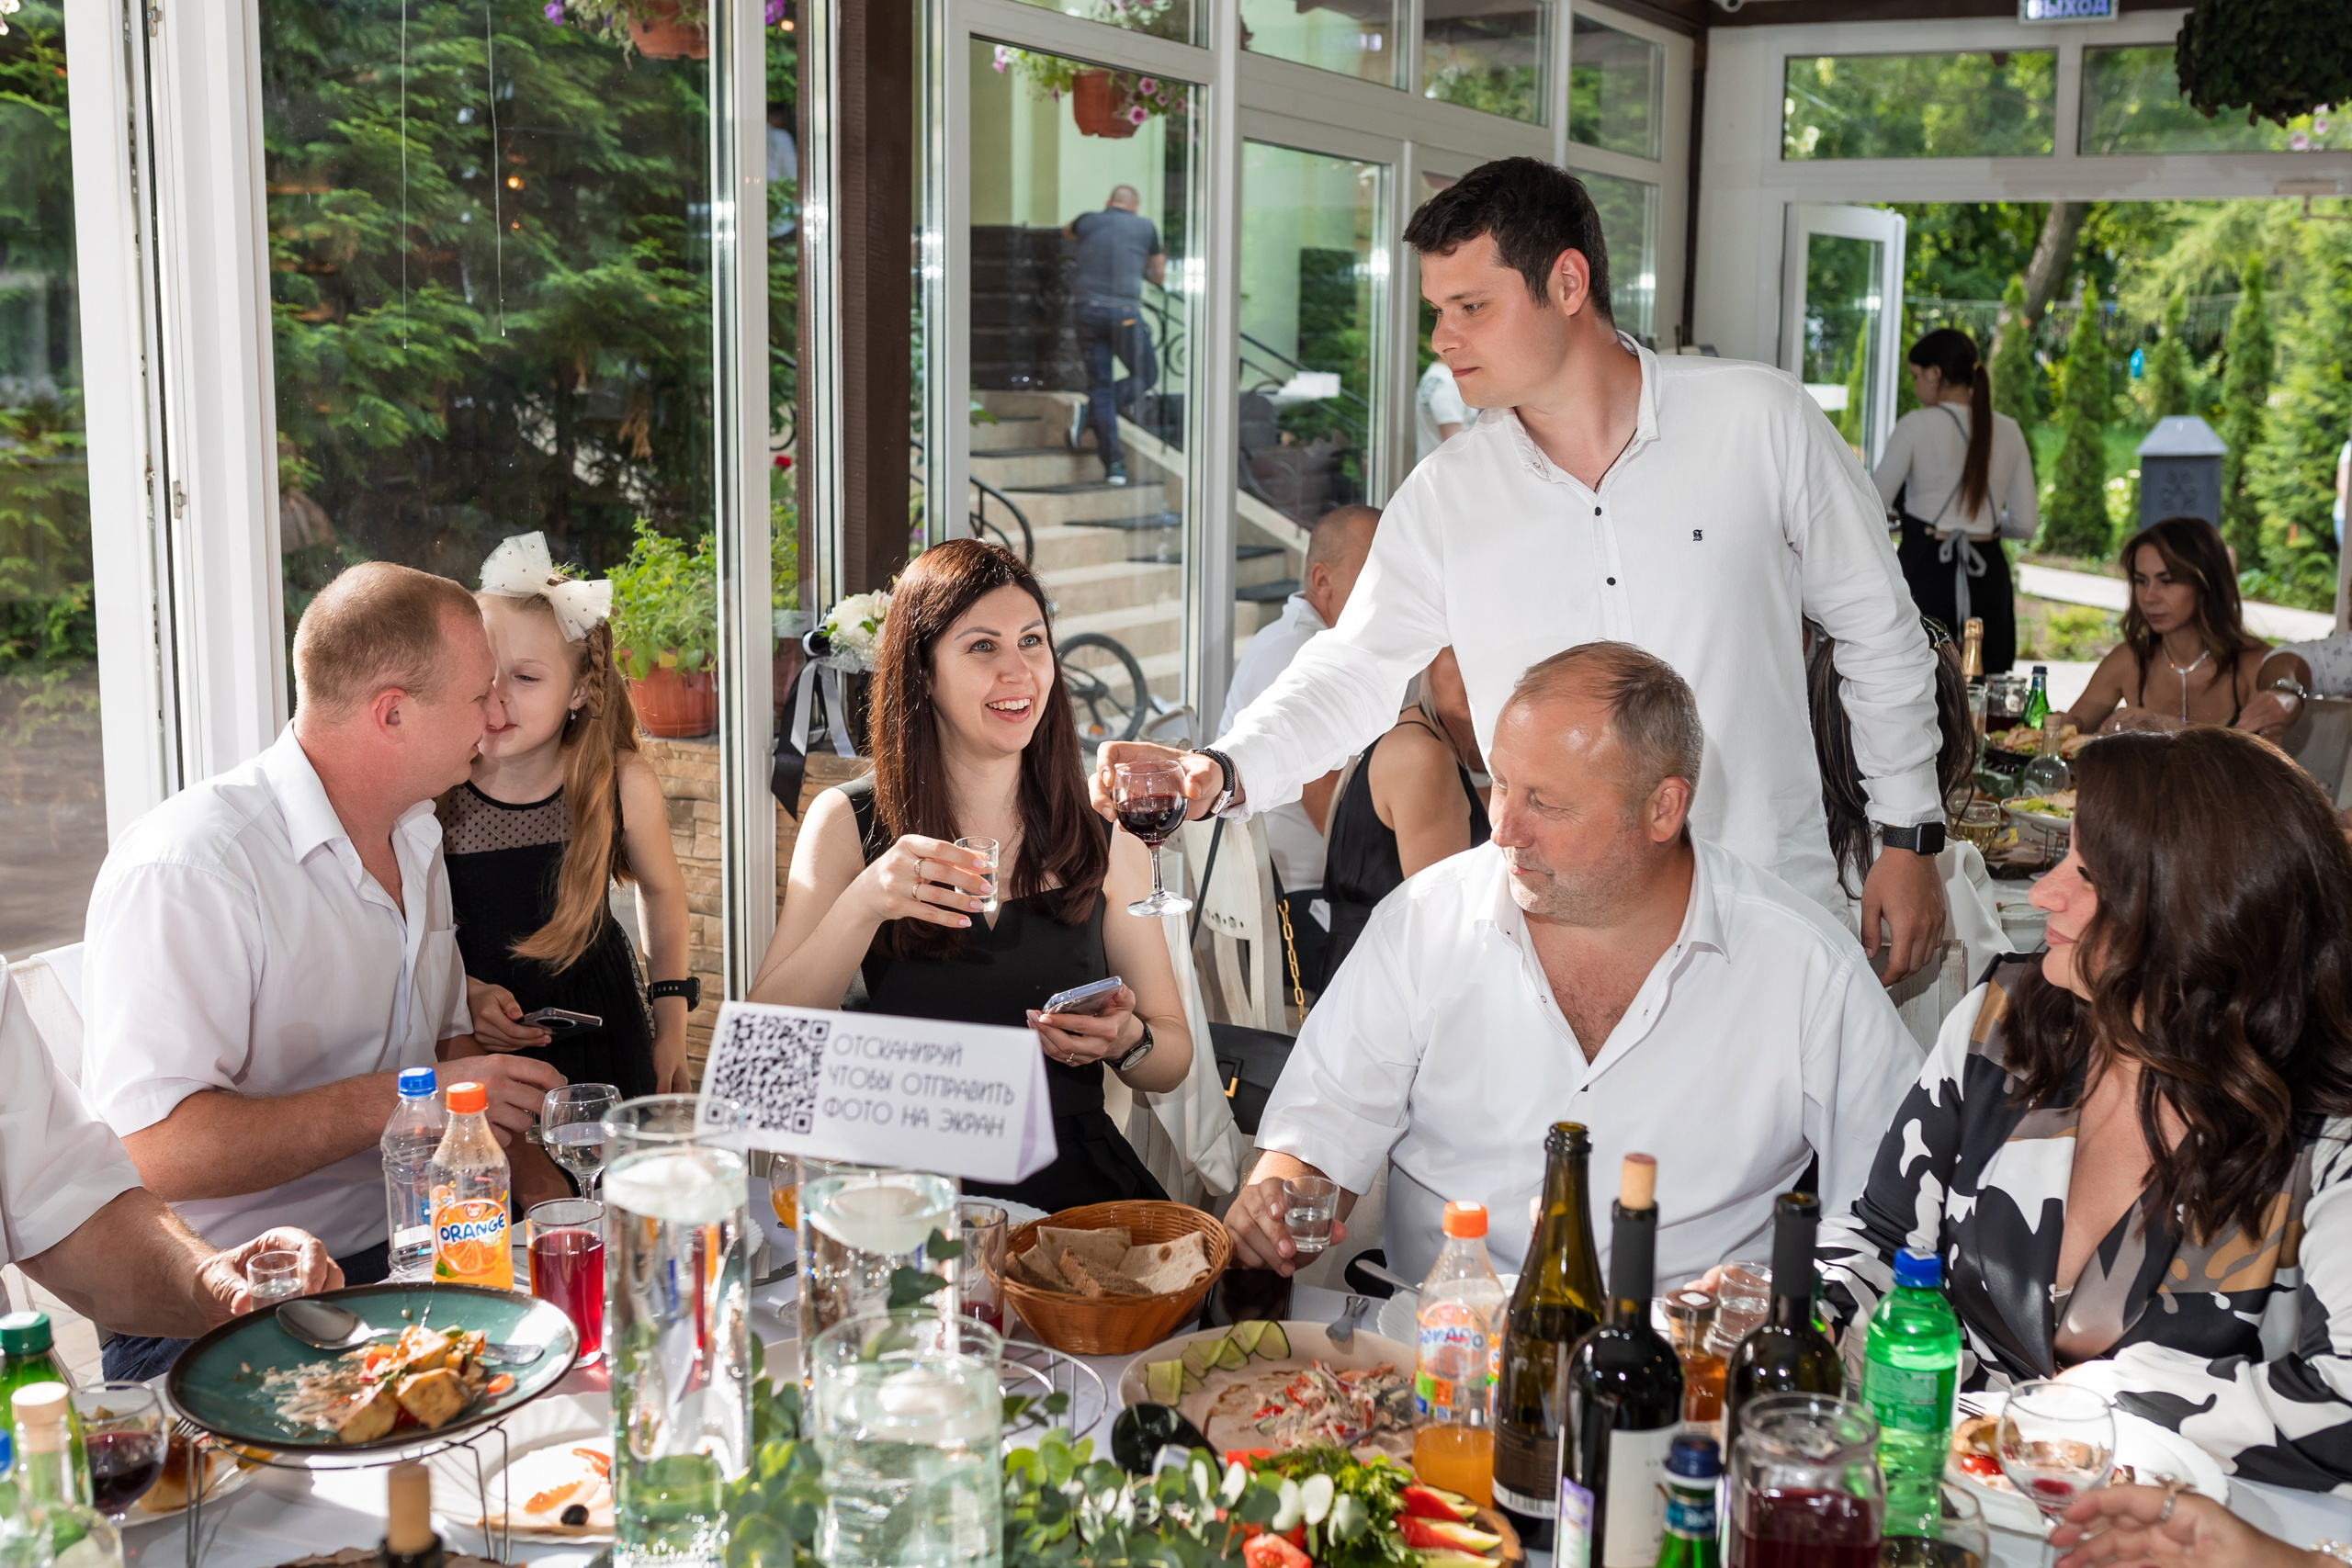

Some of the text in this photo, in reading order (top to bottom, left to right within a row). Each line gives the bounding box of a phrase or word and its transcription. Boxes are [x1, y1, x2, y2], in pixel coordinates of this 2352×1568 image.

[2027, 0, 2109, 19] ВЫХОД
[832, 1032, 963, 1067] ОТСКАНИРУЙ
[828, 1065, 1015, 1105] ЧТОБЫ ОТПРАВИТЬ
[822, 1097, 1005, 1137] ФОТО НА ЭКРАН
[440, 1213, 505, 1243] ORANGE
